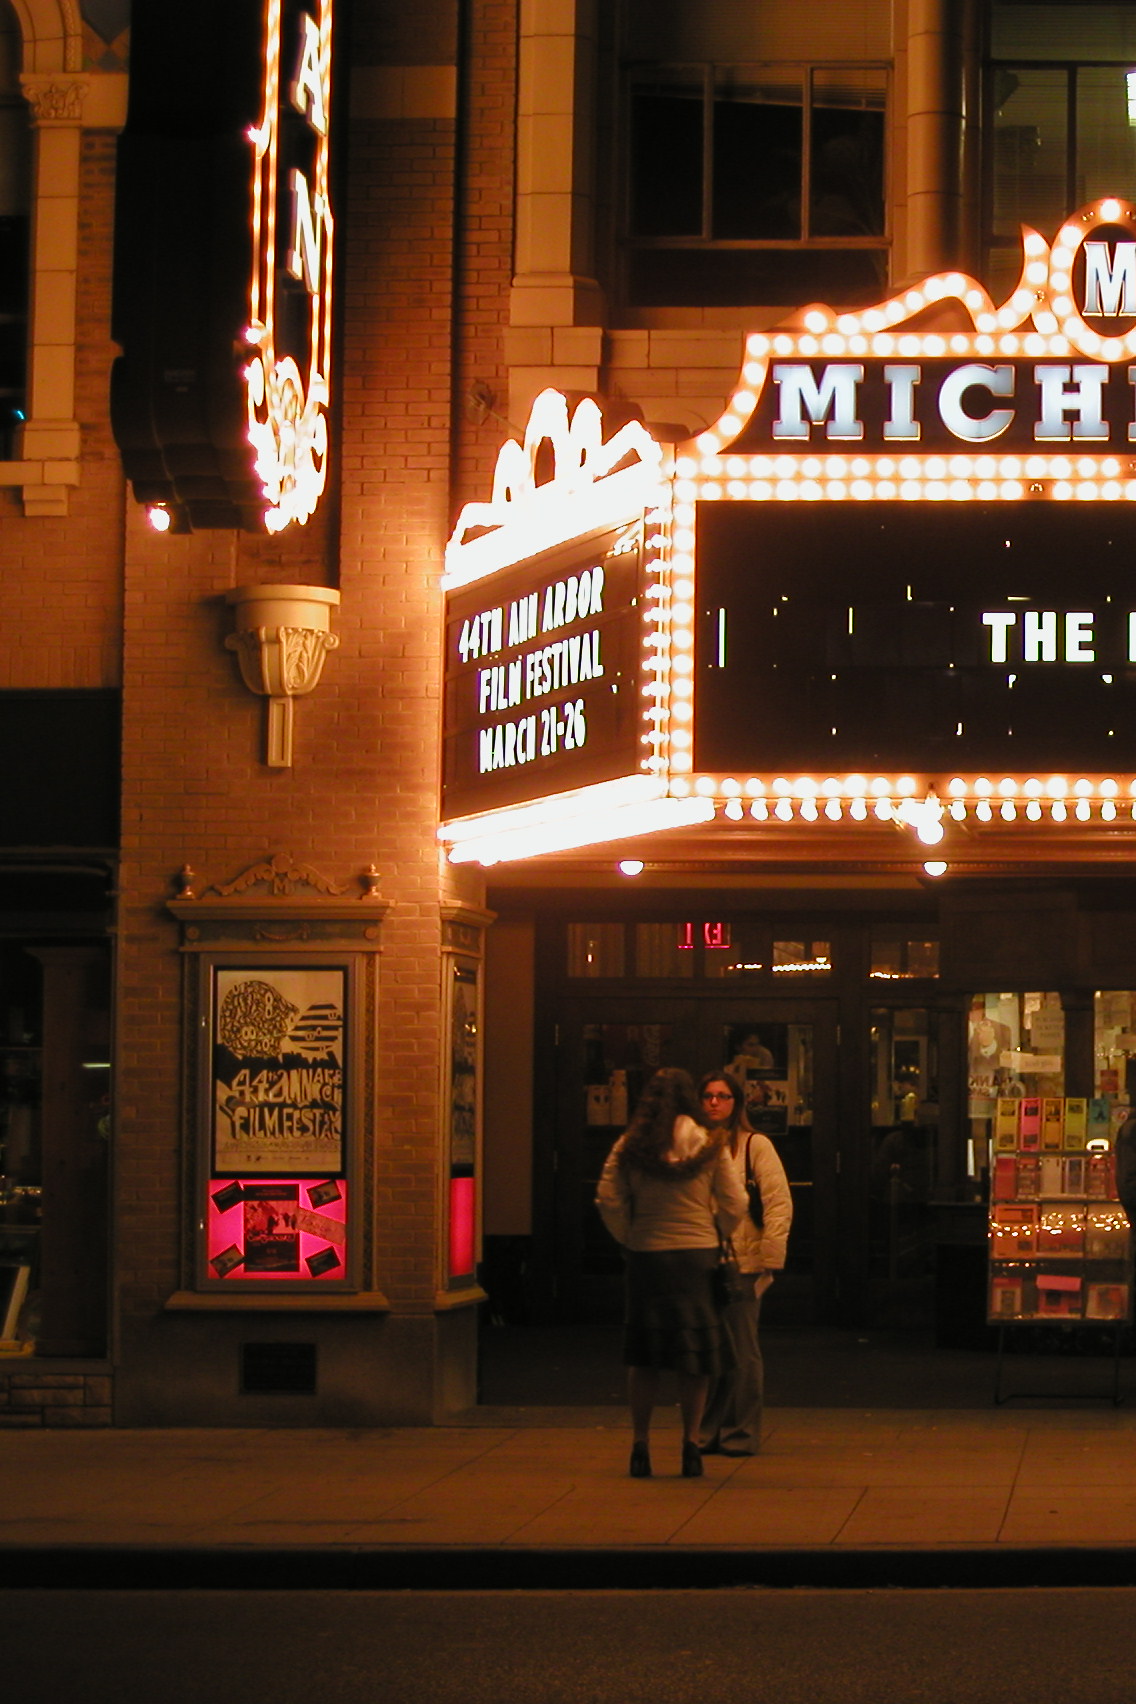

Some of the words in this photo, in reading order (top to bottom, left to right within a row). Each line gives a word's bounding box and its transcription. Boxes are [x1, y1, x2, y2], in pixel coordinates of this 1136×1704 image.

[458, 607, 503, 663] 44TH
[508, 592, 539, 648] ANN
[542, 566, 605, 633] ARBOR
[982, 611, 1095, 663] THE
[479, 660, 522, 714] FILM
[526, 629, 604, 700] FESTIVAL
[479, 715, 536, 774] MARCH
[540, 698, 586, 757] 21-26
[232, 1106, 279, 1139] FILM
